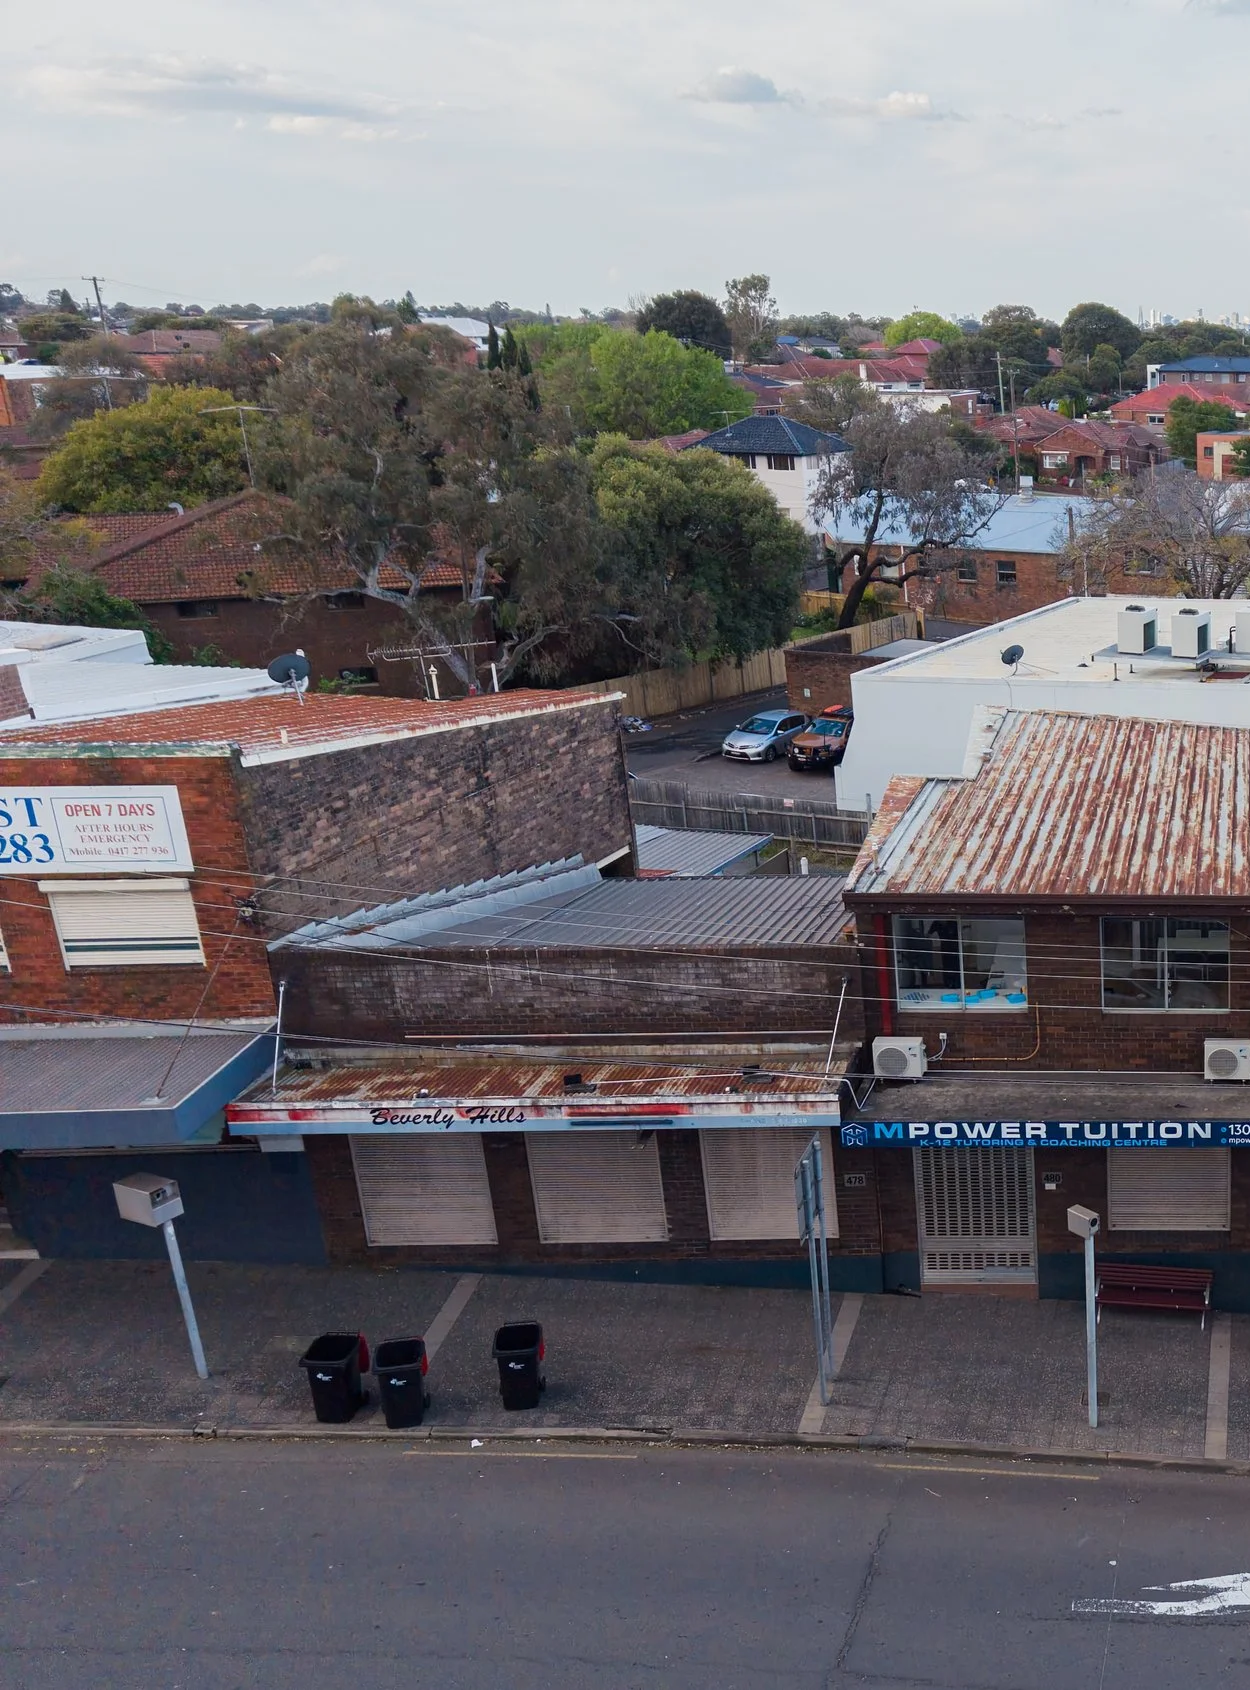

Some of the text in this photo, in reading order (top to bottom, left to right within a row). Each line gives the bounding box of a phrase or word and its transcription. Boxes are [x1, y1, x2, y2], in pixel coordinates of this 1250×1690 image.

[65, 804, 156, 817] OPEN 7 DAYS
[74, 823, 154, 833] AFTER HOURS
[80, 834, 151, 843] EMERGENCY
[68, 846, 169, 856] Mobile 0417 277 936
[369, 1106, 526, 1129] Beverly Hills
[874, 1122, 1212, 1139] MPOWER TUITION
[955, 1139, 1024, 1147] TUTORING
[1041, 1139, 1111, 1147] COACHING
[846, 1176, 863, 1185] 478
[1043, 1174, 1061, 1183] 480
